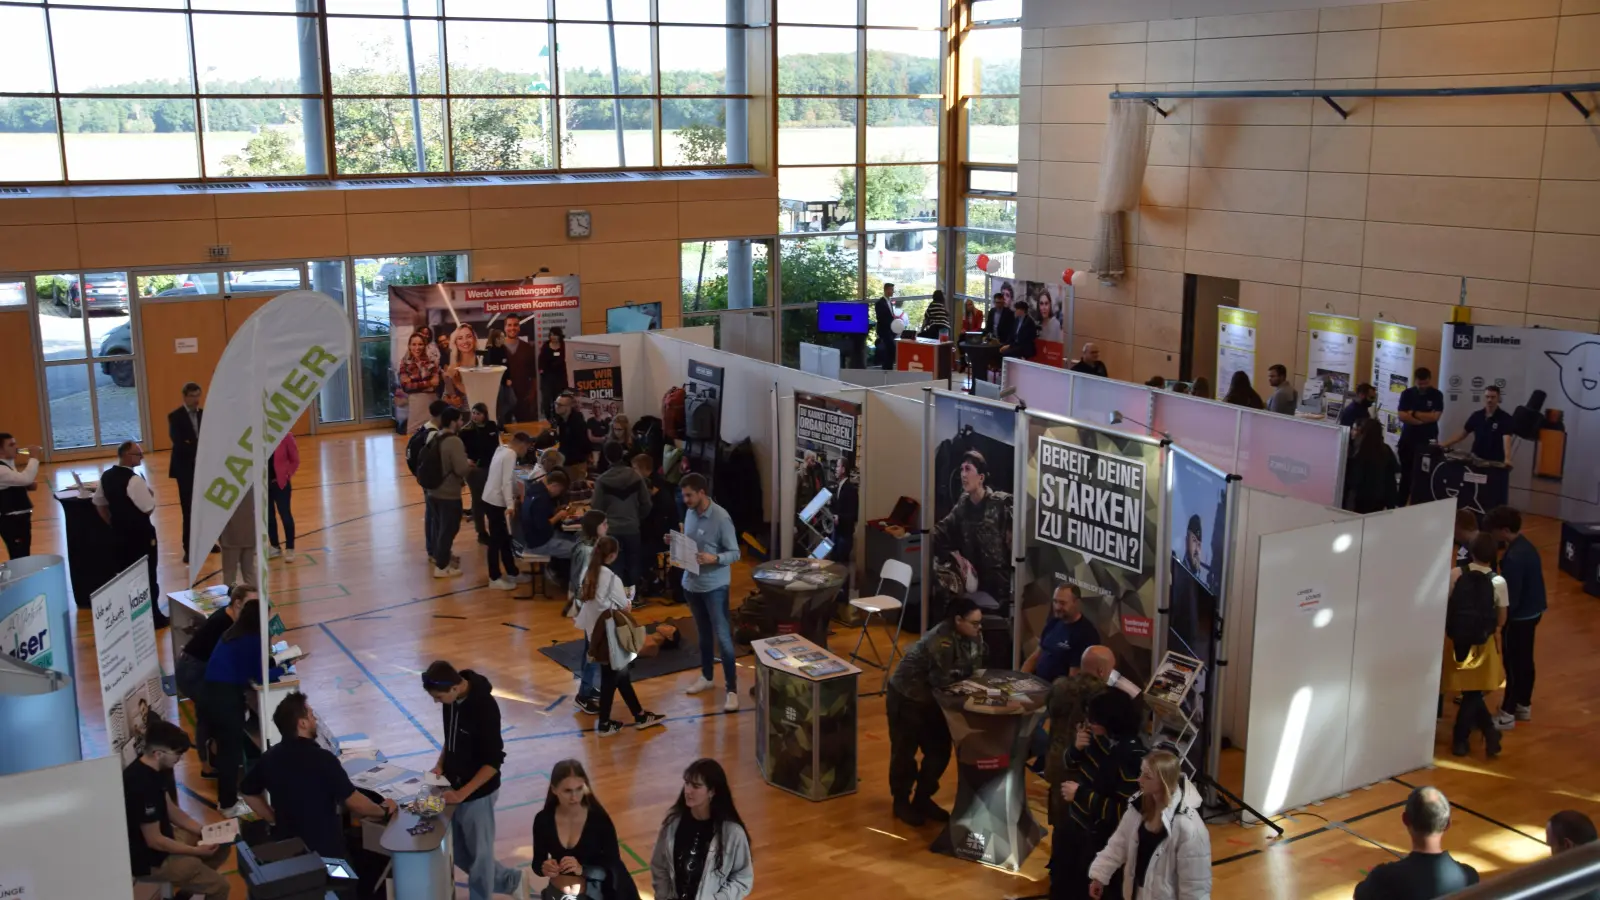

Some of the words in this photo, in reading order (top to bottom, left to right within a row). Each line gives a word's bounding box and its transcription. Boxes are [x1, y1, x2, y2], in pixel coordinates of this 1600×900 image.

[467, 289, 493, 299] Werde
[495, 285, 562, 297] Verwaltungsprofi
[486, 302, 499, 311] bei
[500, 302, 532, 310] unseren
[532, 299, 578, 309] Kommunen
[1476, 335, 1521, 345] heinlein
[594, 369, 612, 378] WIR
[577, 379, 613, 390] SUCHEN
[590, 389, 613, 399] DICH!
[800, 407, 808, 416] DU
[808, 409, 826, 421] KANNST
[827, 413, 838, 424] DEIN
[839, 416, 852, 428] BÜRO
[800, 417, 852, 440] ORGANISIEREN.
[811, 431, 821, 440] EINE
[1042, 444, 1092, 480] BEREIT,
[1097, 458, 1140, 490] DEINE
[1041, 473, 1139, 533] STÄRKEN
[1040, 511, 1061, 539] ZU
[1068, 518, 1138, 564] FINDEN?
[128, 588, 149, 610] kaiser
